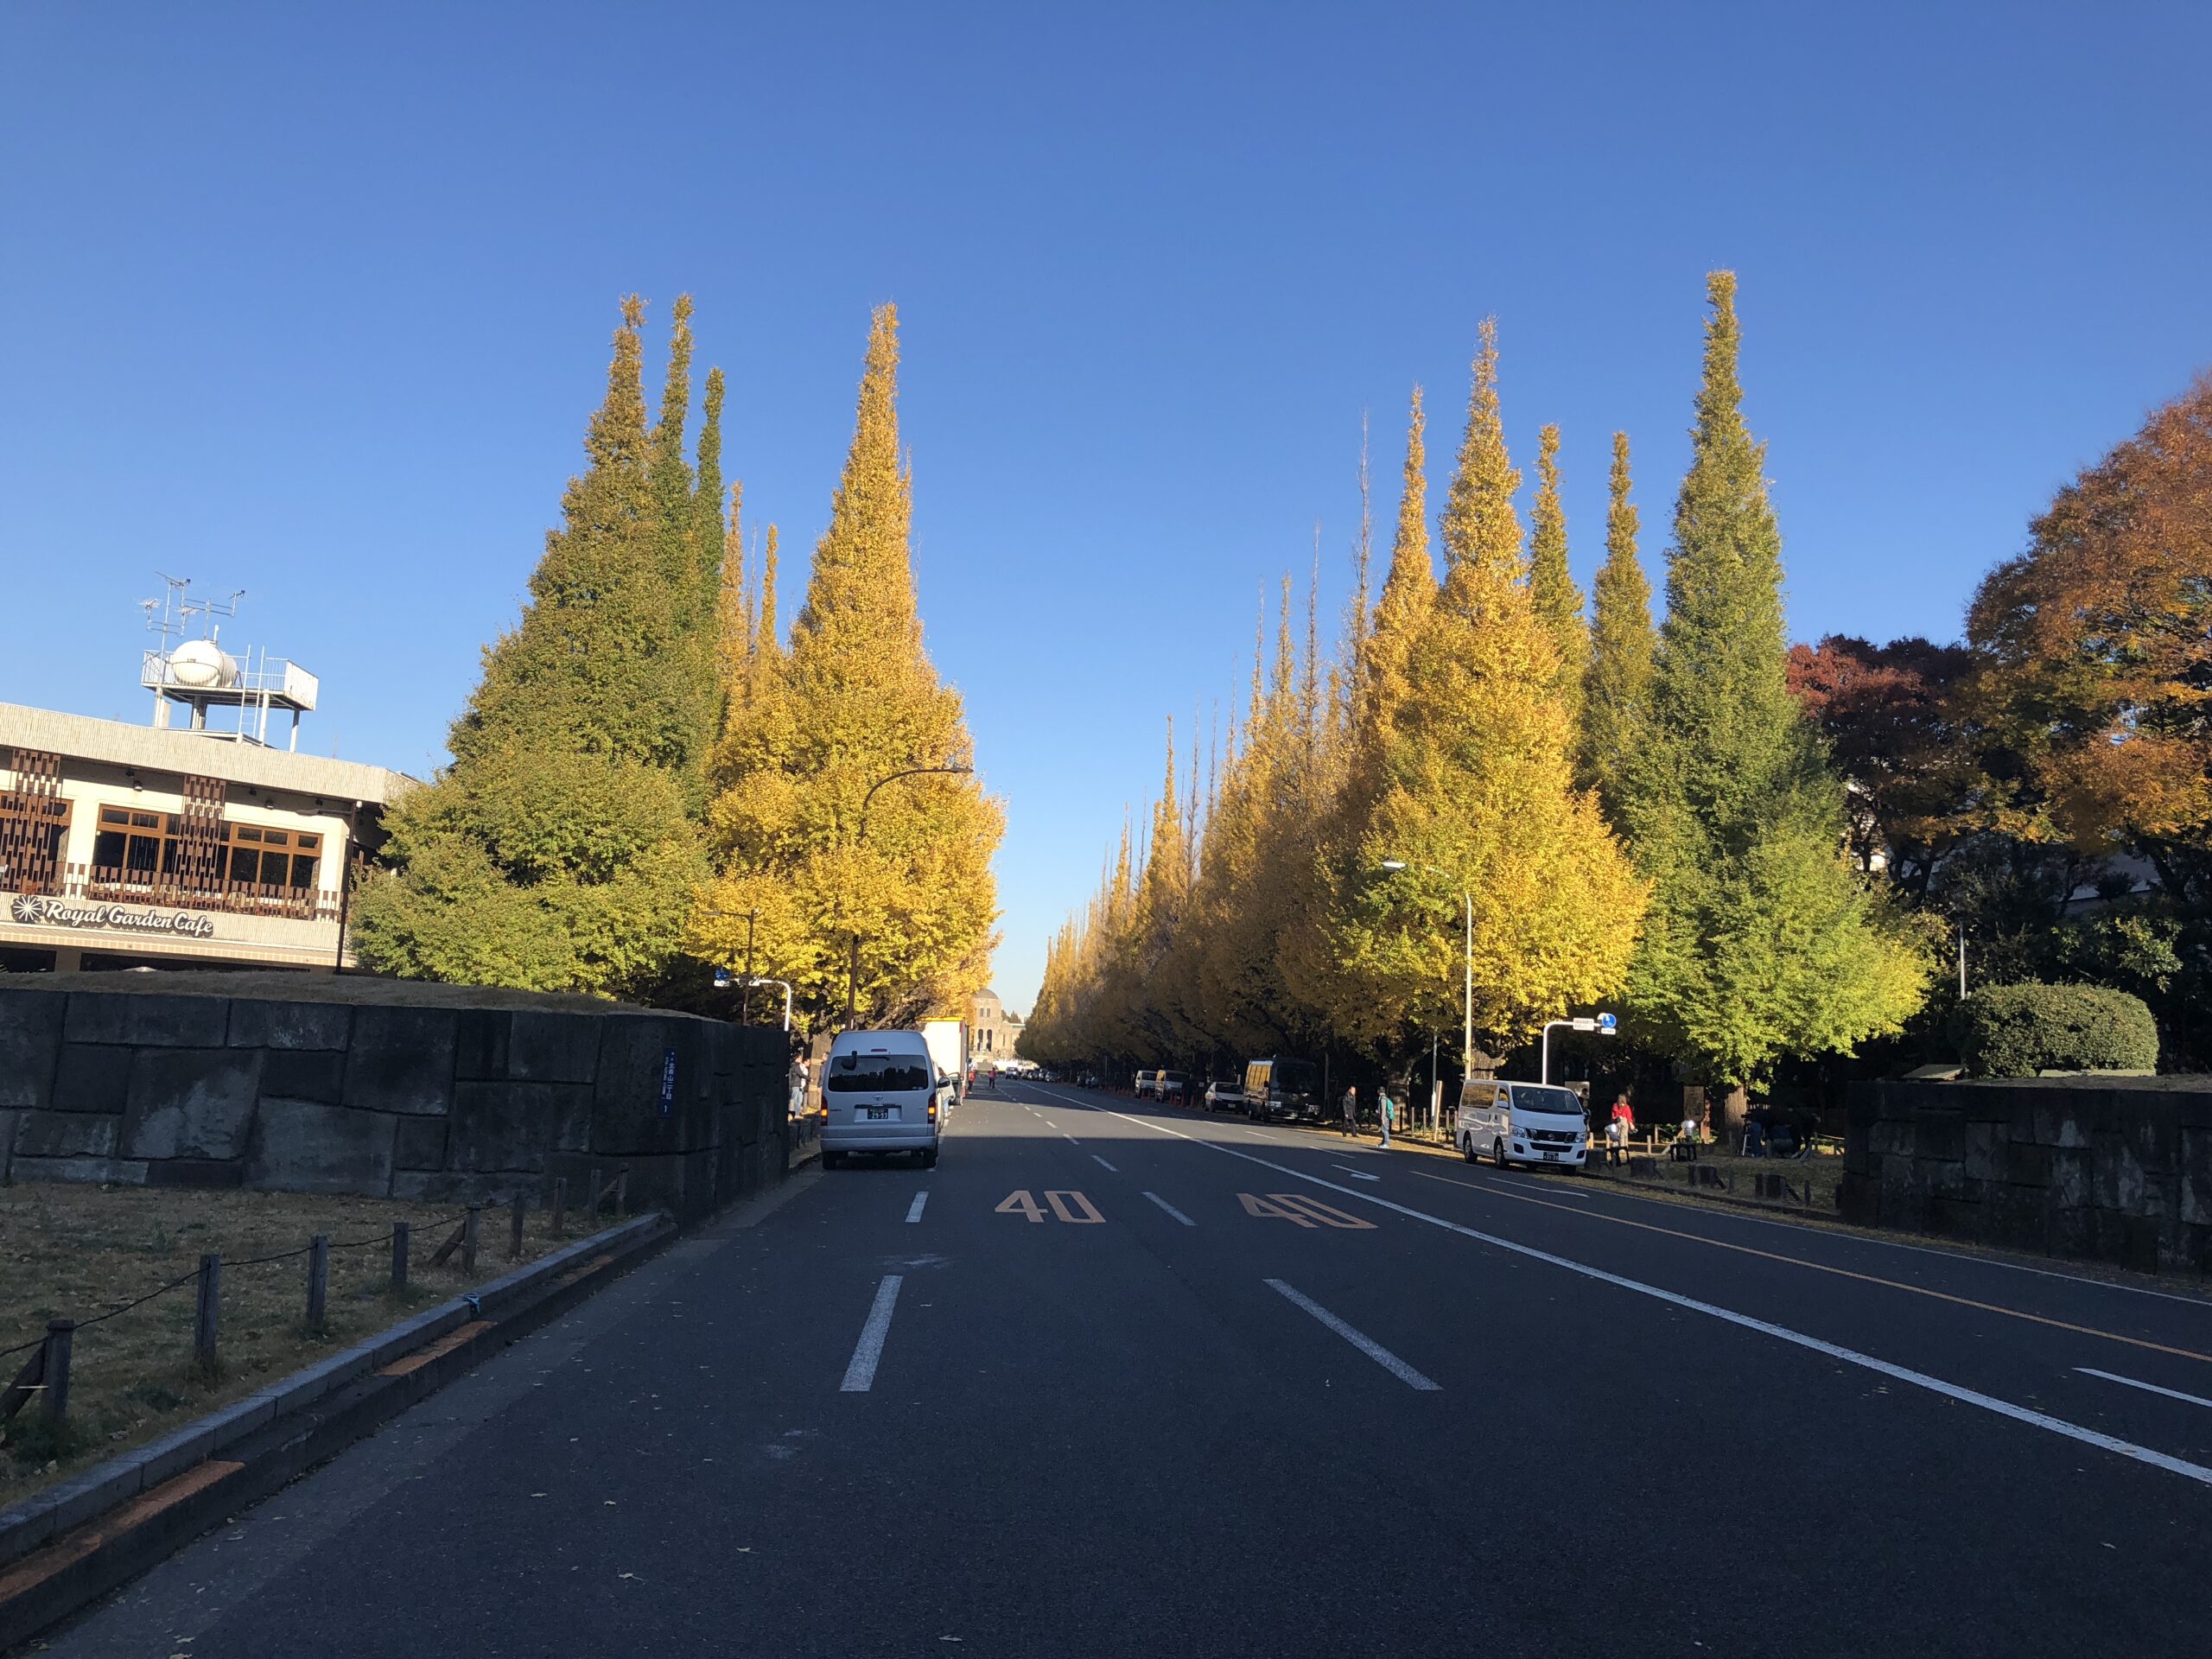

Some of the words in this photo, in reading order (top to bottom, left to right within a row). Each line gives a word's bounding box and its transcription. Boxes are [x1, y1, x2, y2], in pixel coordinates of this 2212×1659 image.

[46, 900, 105, 926] Royal
[108, 906, 173, 929] Garden
[175, 912, 213, 937] Cafe
[995, 1190, 1106, 1223] 40
[1236, 1193, 1378, 1228] 40
